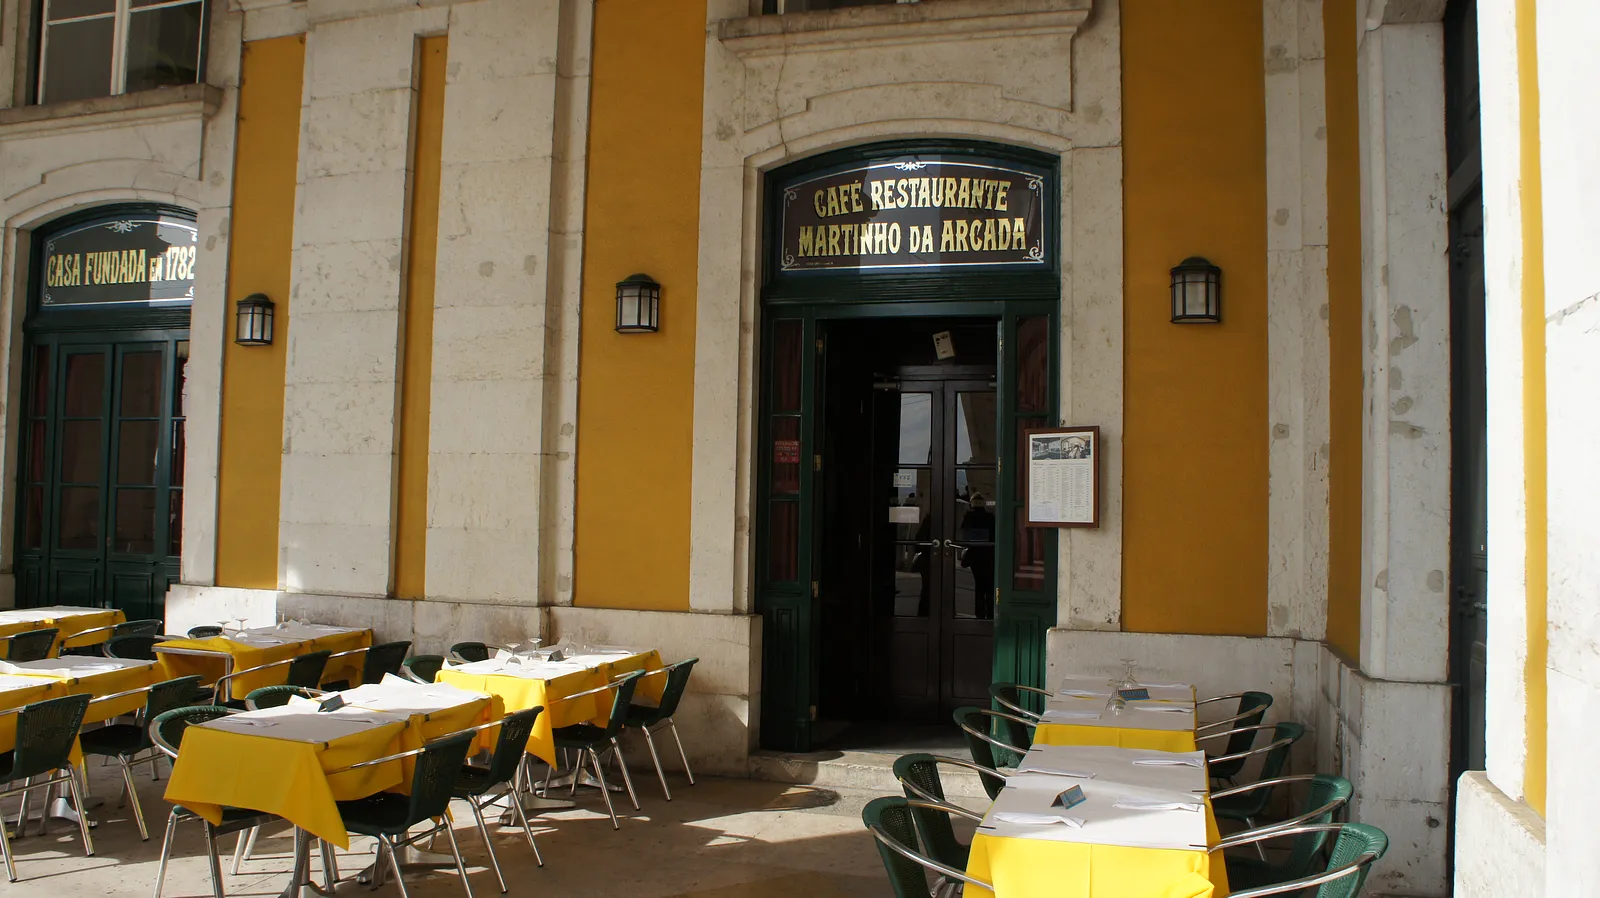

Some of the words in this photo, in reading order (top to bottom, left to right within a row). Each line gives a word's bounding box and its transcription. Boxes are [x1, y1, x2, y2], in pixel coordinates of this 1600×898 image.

[814, 180, 864, 218] CAFÉ
[870, 178, 1011, 212] RESTAURANTE
[798, 222, 901, 257] MARTINHO
[909, 225, 934, 254] DA
[940, 217, 1027, 252] ARCADA
[47, 253, 81, 287] CASA
[84, 249, 146, 286] FUNDADA
[165, 245, 197, 281] 1782
